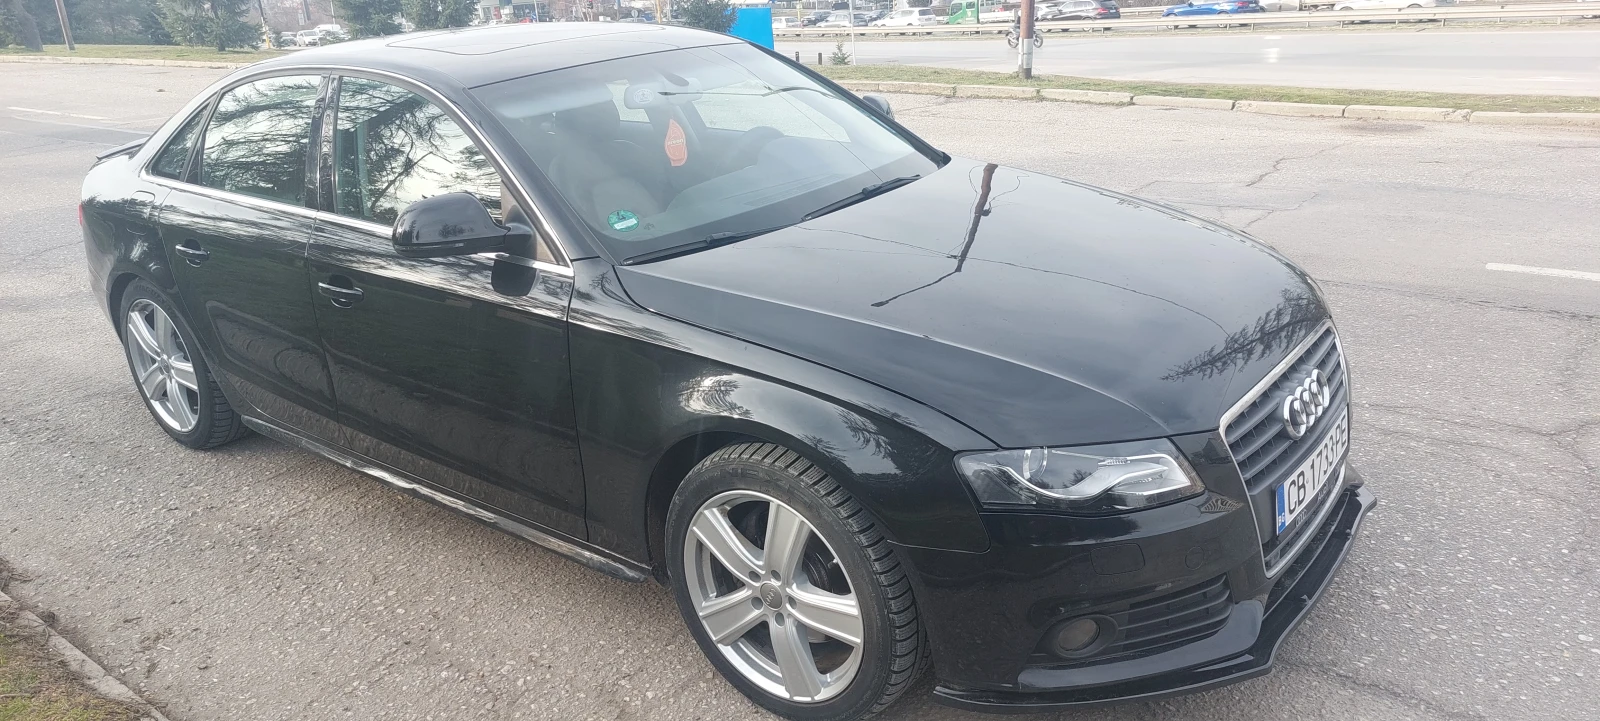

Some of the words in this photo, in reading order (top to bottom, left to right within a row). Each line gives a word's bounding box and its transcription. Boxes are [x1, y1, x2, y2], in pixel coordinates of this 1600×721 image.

[1288, 470, 1306, 515] CB
[1310, 434, 1334, 491] 1733
[1335, 414, 1347, 458] PE
